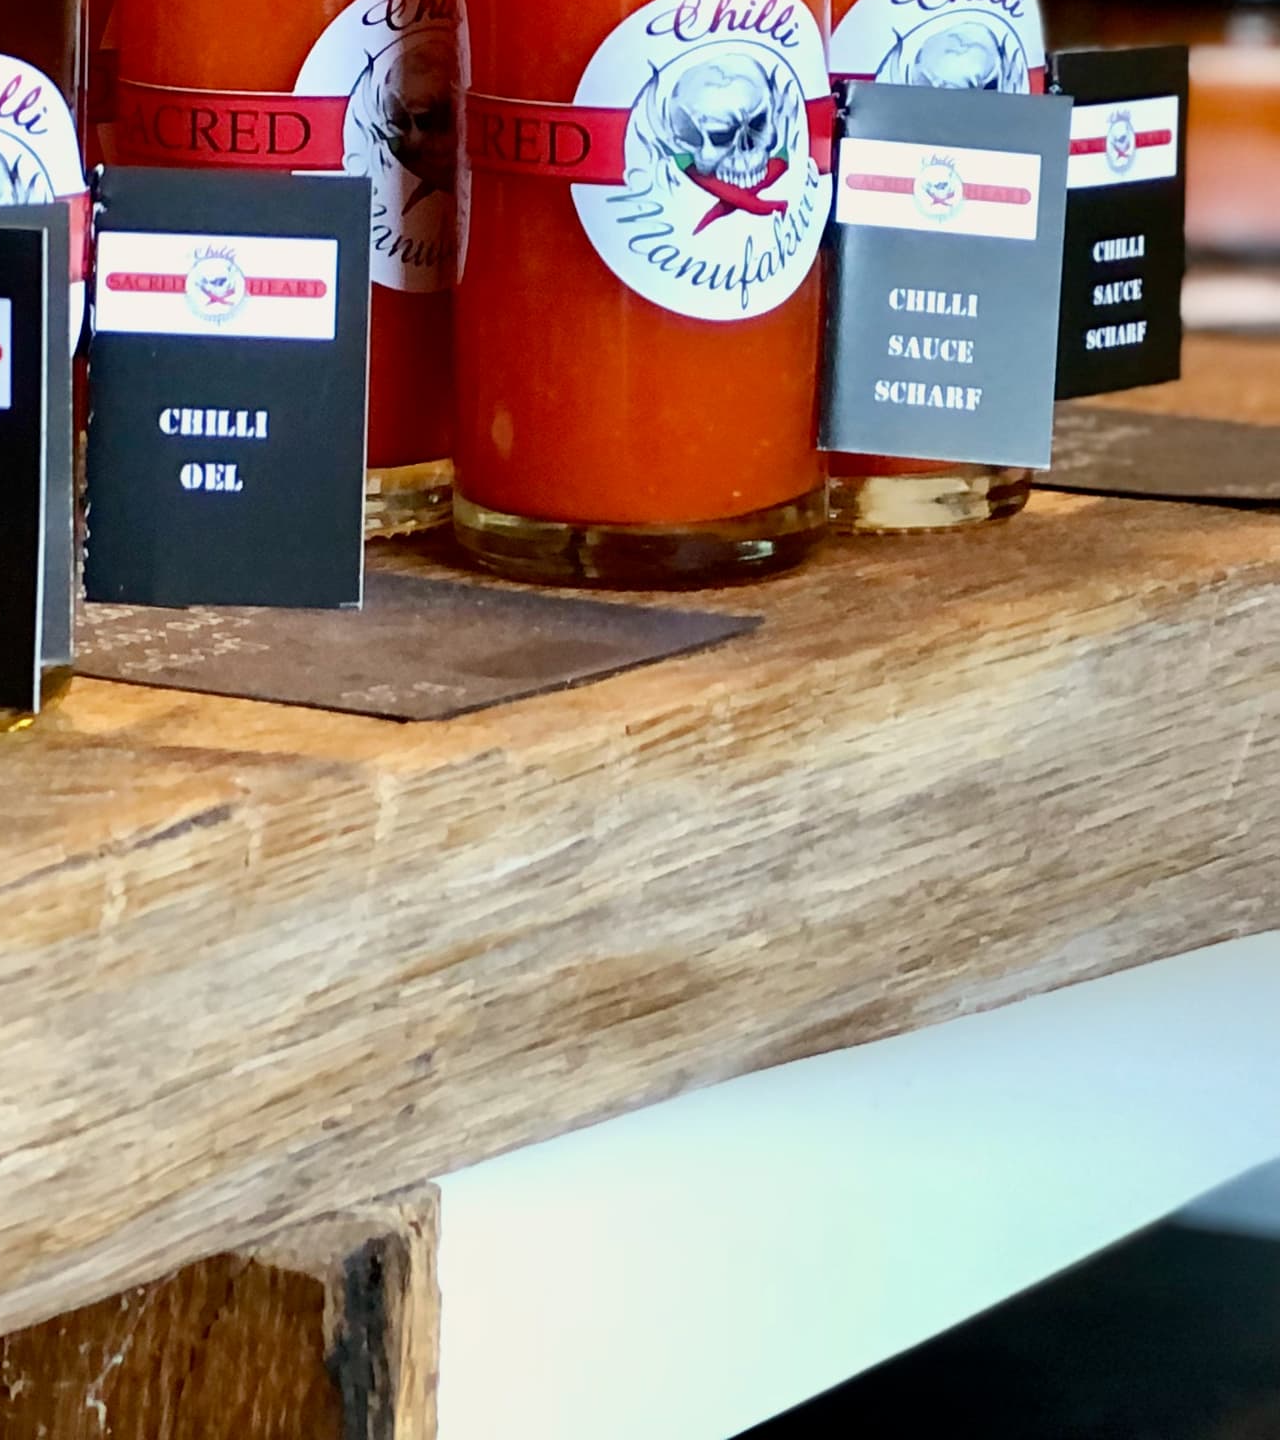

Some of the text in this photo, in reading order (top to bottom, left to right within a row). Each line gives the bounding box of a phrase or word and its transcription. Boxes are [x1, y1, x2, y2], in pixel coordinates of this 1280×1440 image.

[126, 102, 312, 156] ACRED
[480, 112, 592, 169] RED
[606, 164, 820, 310] Manufaktur
[1092, 234, 1145, 263] CHILLI
[888, 288, 979, 318] CHILLI
[1093, 278, 1143, 306] SAUCE
[887, 334, 975, 364] SAUCE
[1085, 321, 1148, 350] SCHARF
[874, 379, 983, 411] SCHARF
[158, 408, 268, 439] CHILLI
[179, 463, 243, 491] OEL
